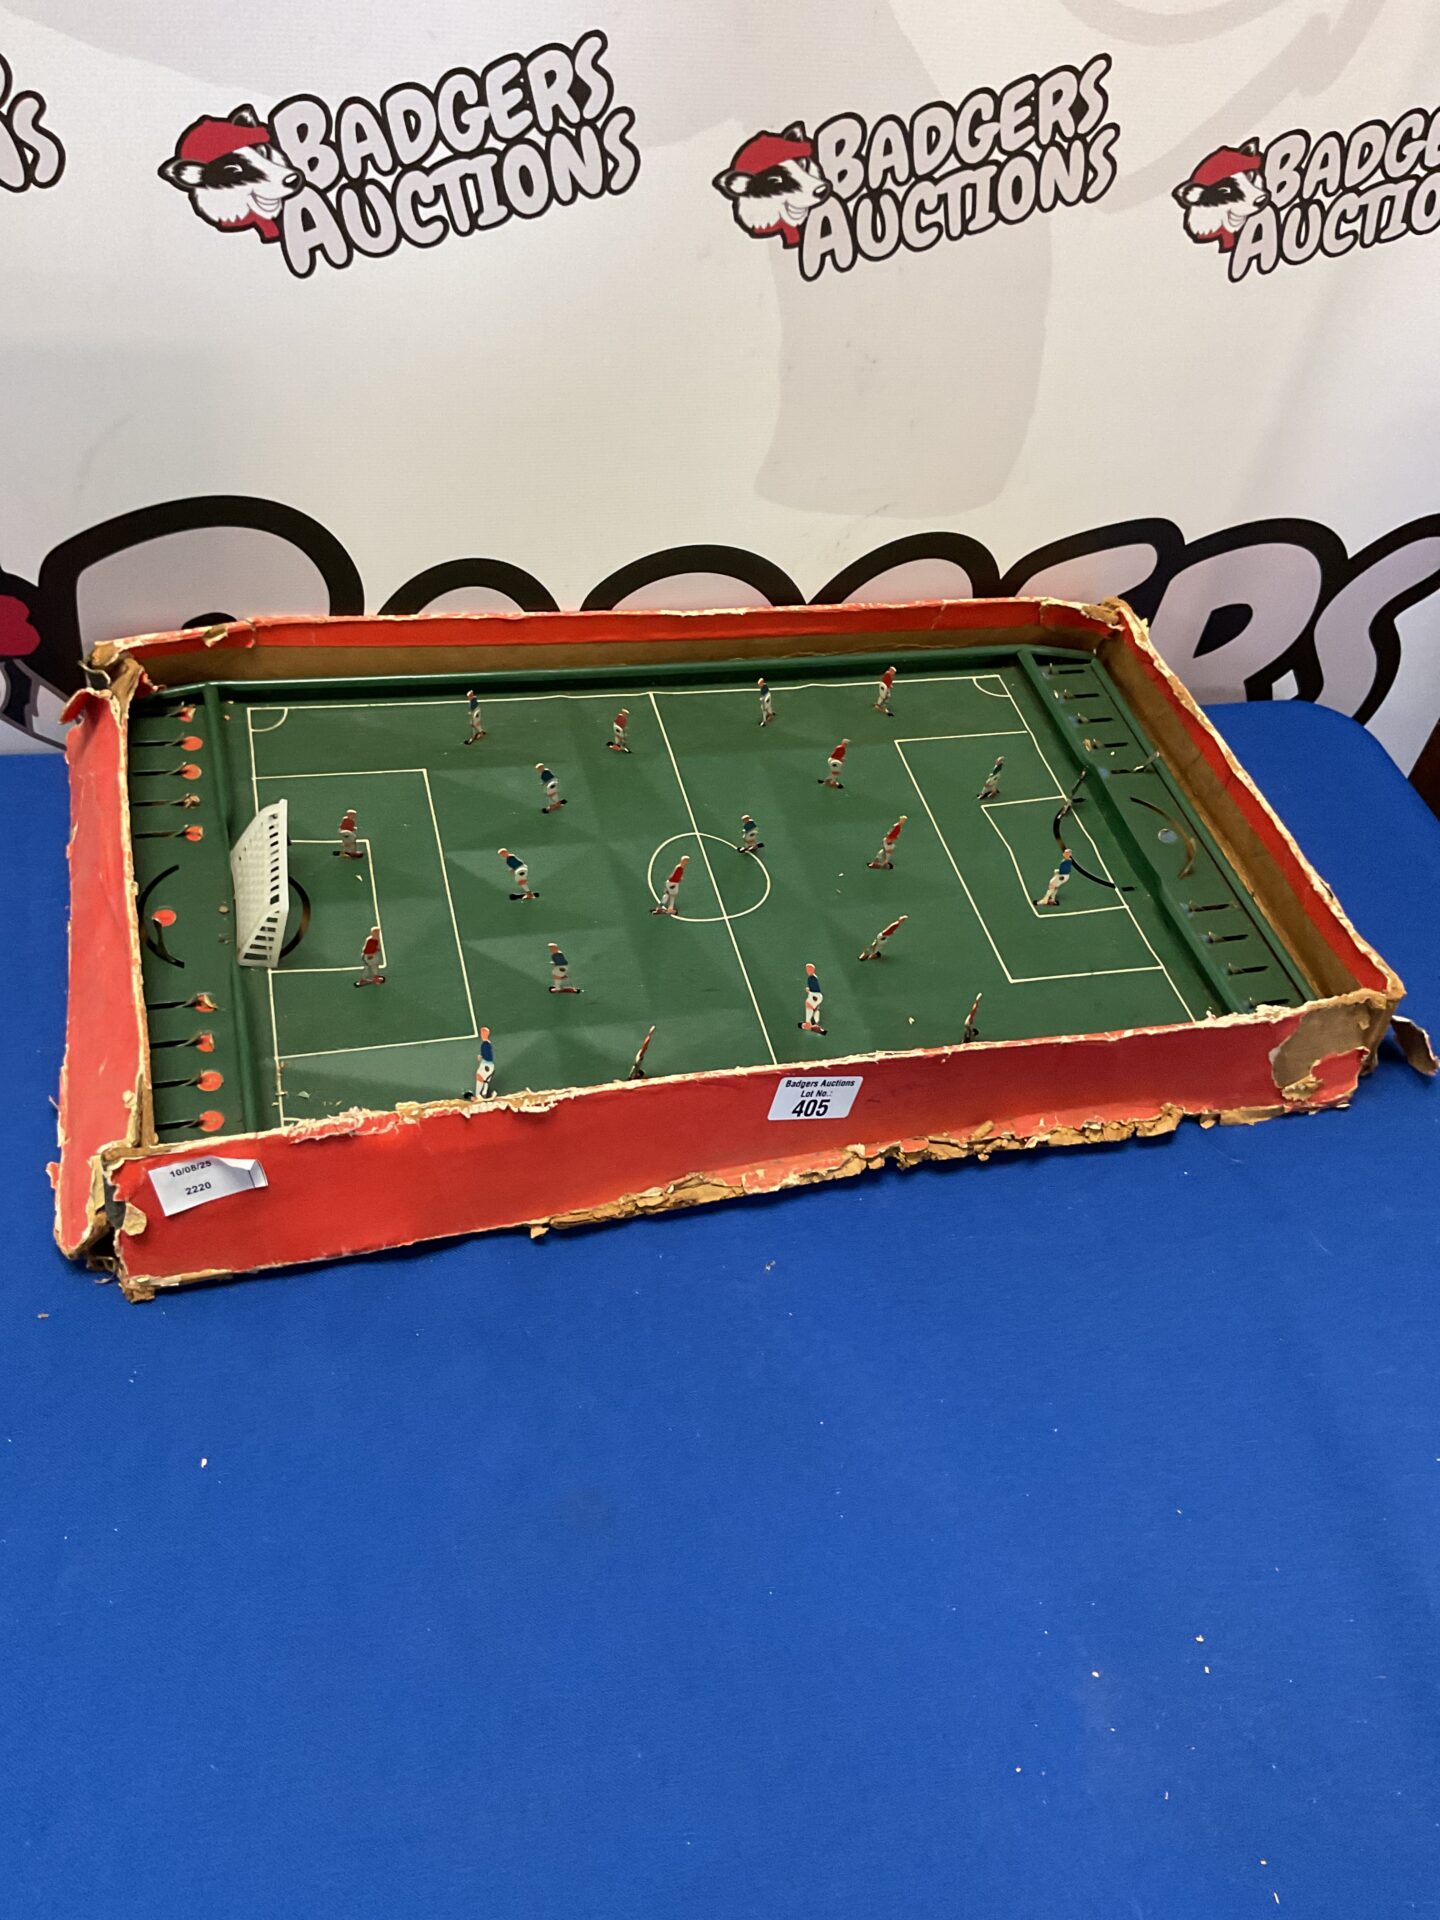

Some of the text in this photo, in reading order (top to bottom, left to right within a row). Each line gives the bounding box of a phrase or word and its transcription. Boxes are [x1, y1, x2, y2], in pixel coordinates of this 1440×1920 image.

[268, 29, 614, 193] BADGERS
[814, 52, 1113, 200] BADGERS
[279, 106, 641, 279] AUCTIONS
[799, 122, 1121, 282] AUCTIONS
[785, 1079, 856, 1089] Badgers Auctions
[792, 1098, 831, 1118] 405
[800, 1089, 813, 1098] Lot
[184, 1181, 212, 1196] 2220
